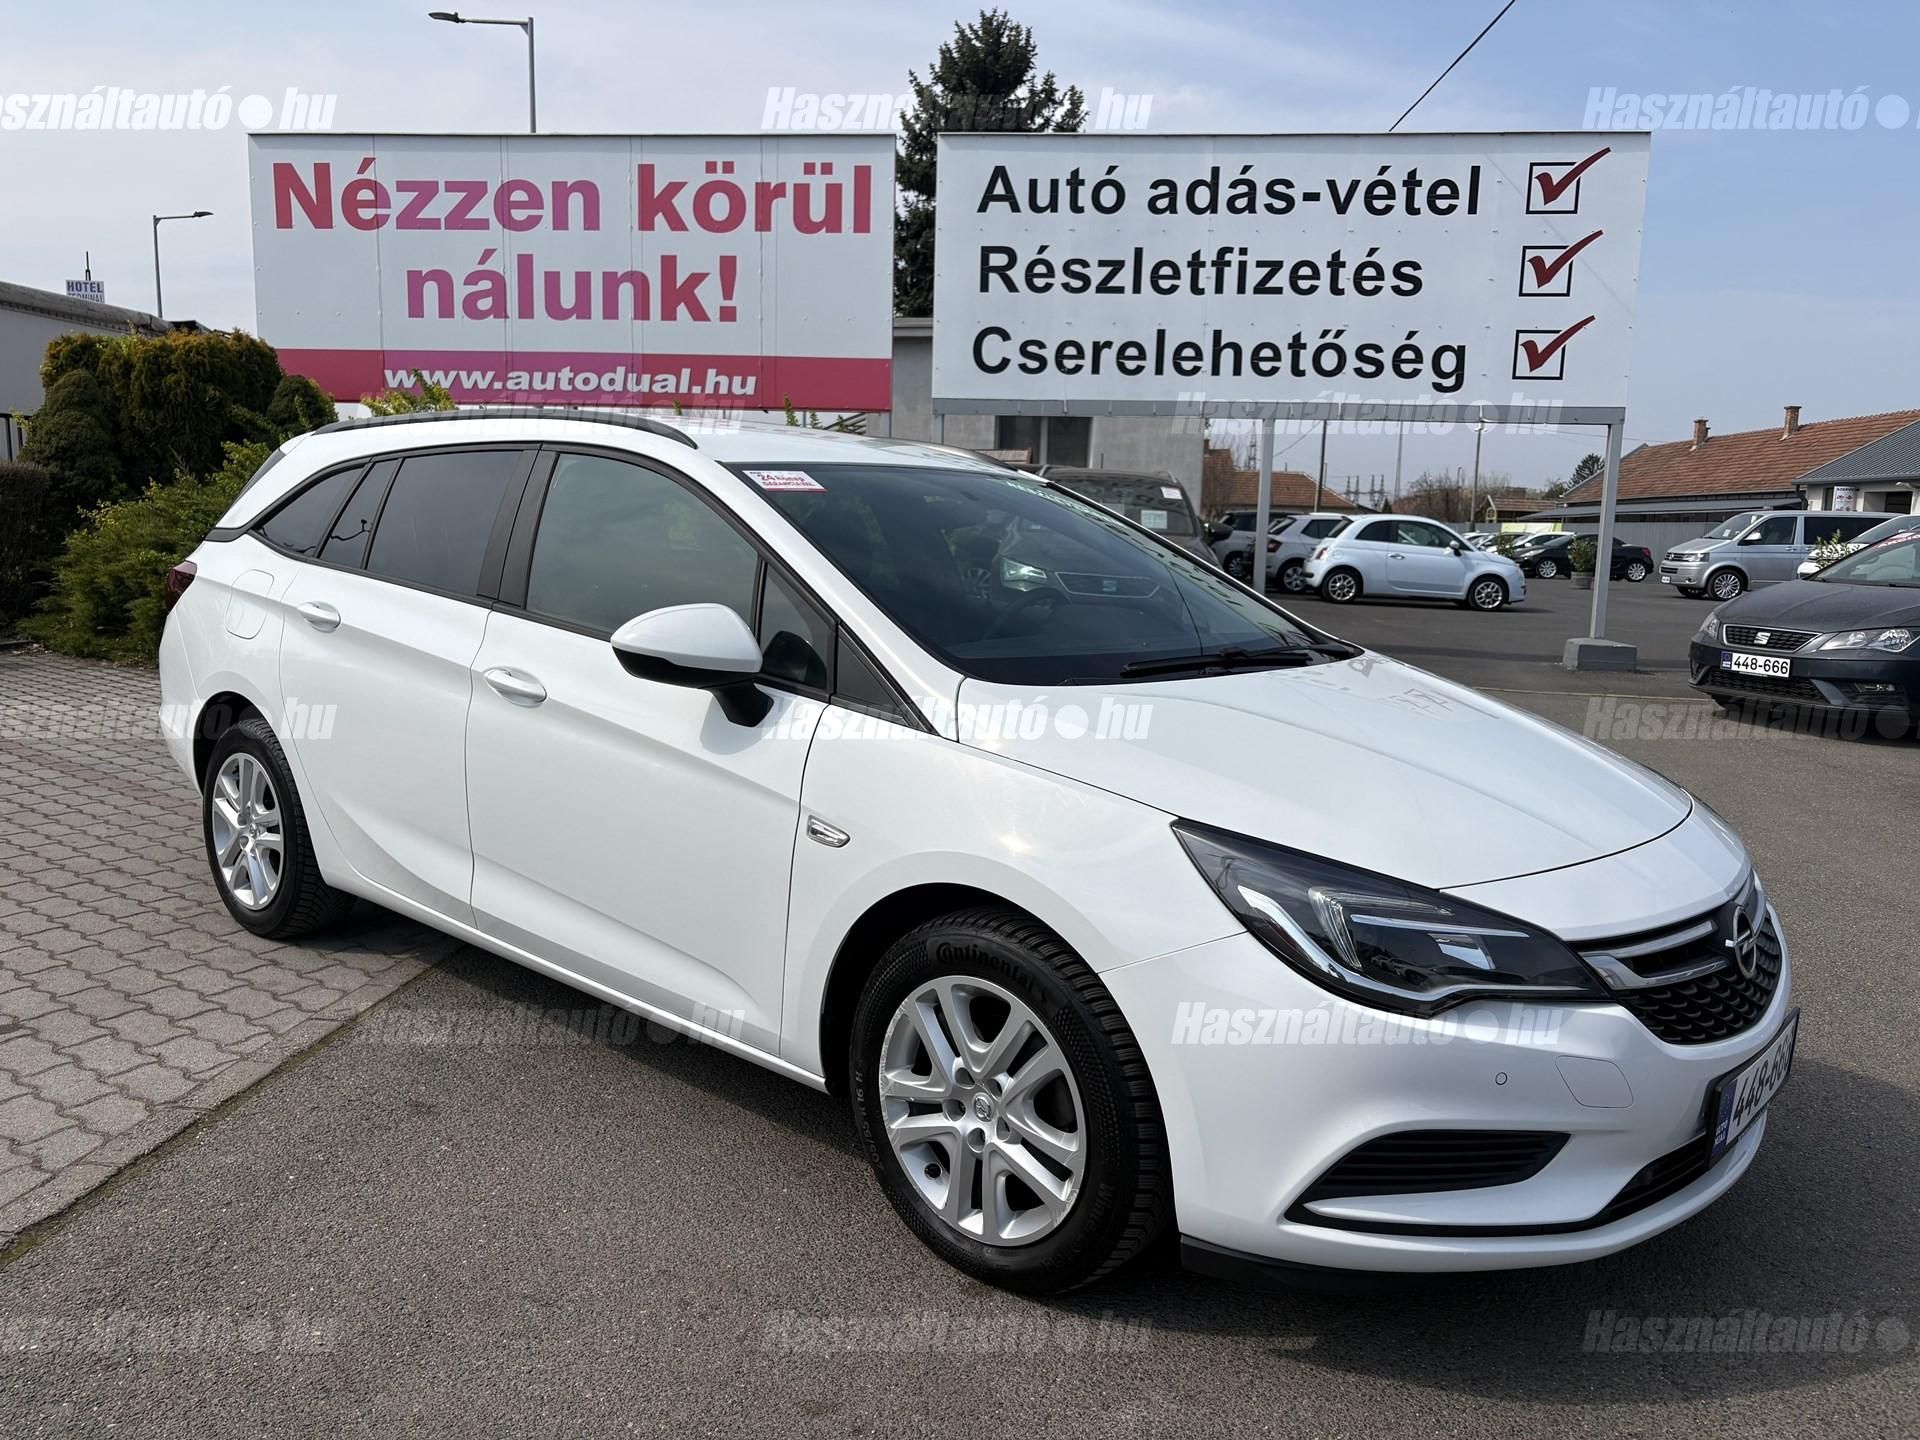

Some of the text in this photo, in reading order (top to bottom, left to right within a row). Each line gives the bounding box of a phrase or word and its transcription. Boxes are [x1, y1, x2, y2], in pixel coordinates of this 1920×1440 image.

[272, 157, 872, 234] Nézzen körül
[976, 164, 1482, 216] Autó adás-vétel
[67, 281, 104, 293] HOTEL
[407, 248, 738, 323] nálunk!
[979, 244, 1424, 297] Részletfizetés
[384, 365, 757, 396] www.autodual.hu
[972, 325, 1468, 395] Cserelehetőség
[1733, 655, 1789, 675] 448-666
[935, 941, 1036, 993] Continental
